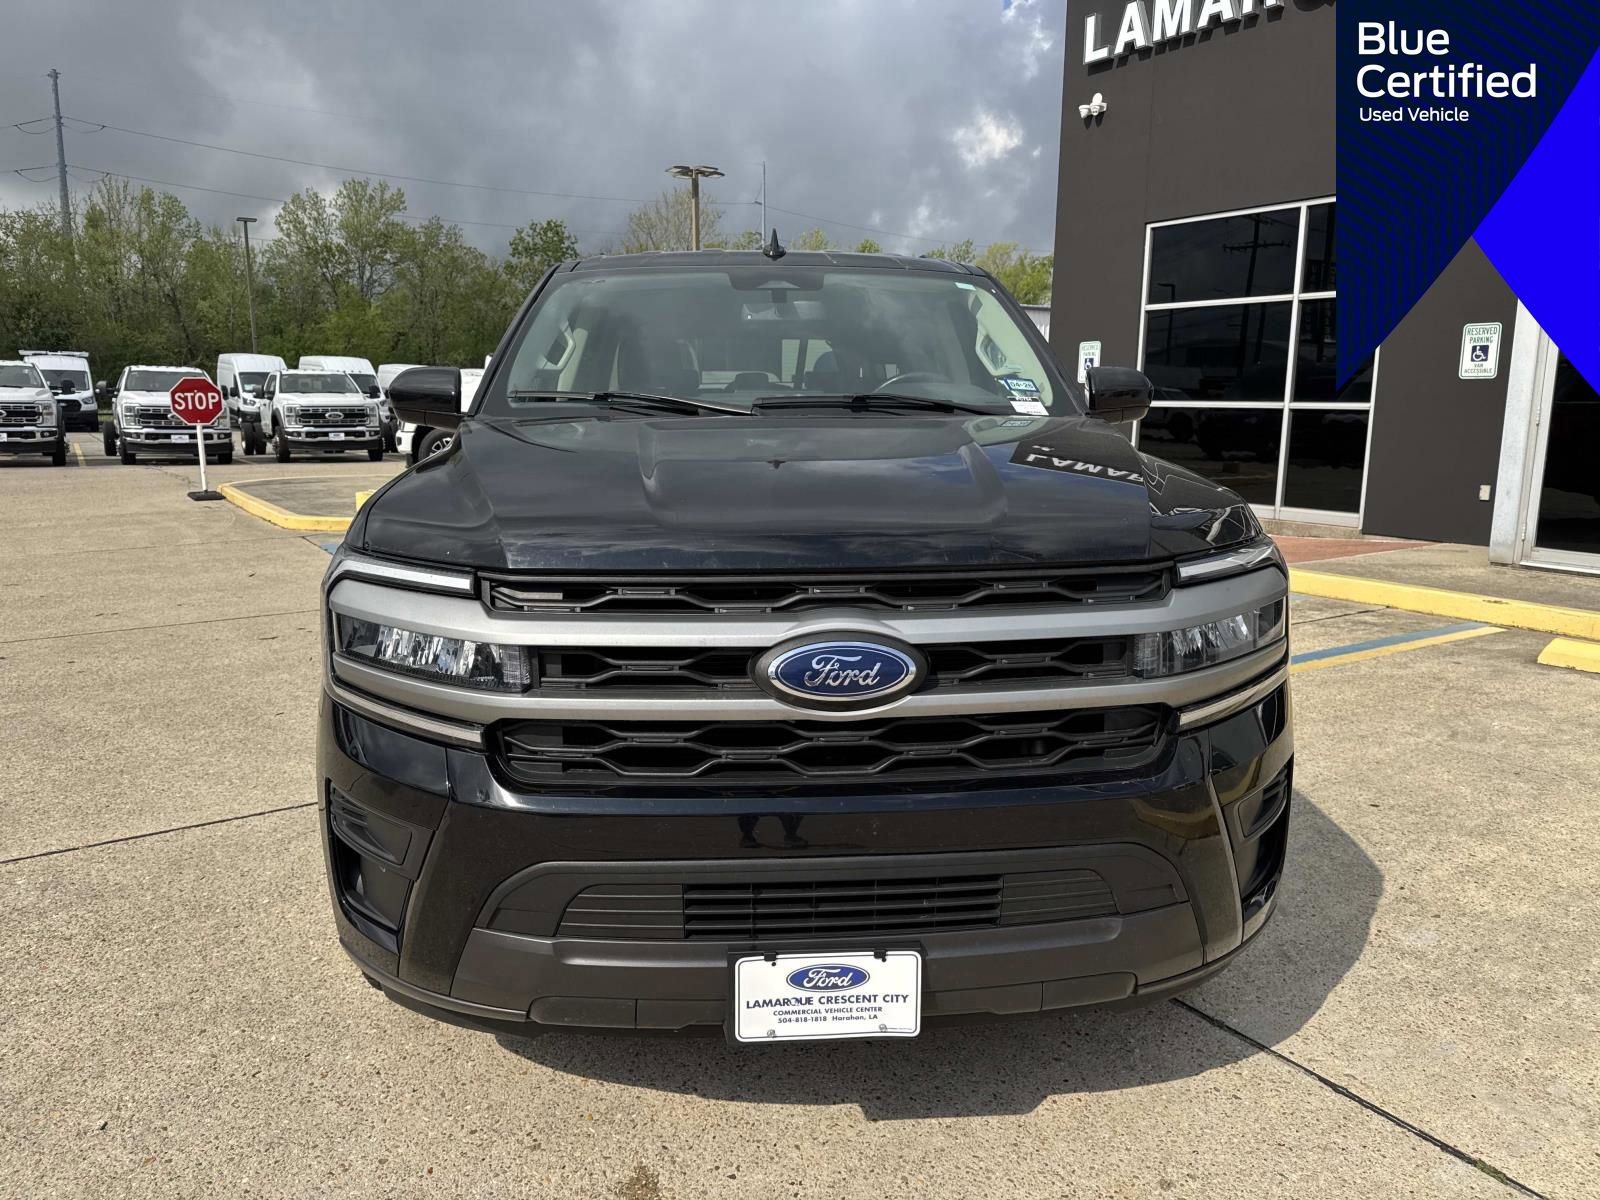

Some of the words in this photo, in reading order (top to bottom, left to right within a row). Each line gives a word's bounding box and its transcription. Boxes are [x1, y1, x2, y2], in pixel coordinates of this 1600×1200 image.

[1083, 0, 1284, 64] LAMA
[1467, 327, 1498, 336] RESERVED
[1469, 336, 1493, 344] PARKING
[174, 392, 219, 410] STOP
[804, 654, 882, 687] Ford
[803, 968, 853, 988] Ford
[746, 996, 814, 1009] LAMARQUE
[818, 994, 878, 1005] CRESCENT
[882, 993, 909, 1003] CITY
[773, 1008, 822, 1016] COMMERCIAL
[777, 1015, 828, 1024] 504-818-1818
